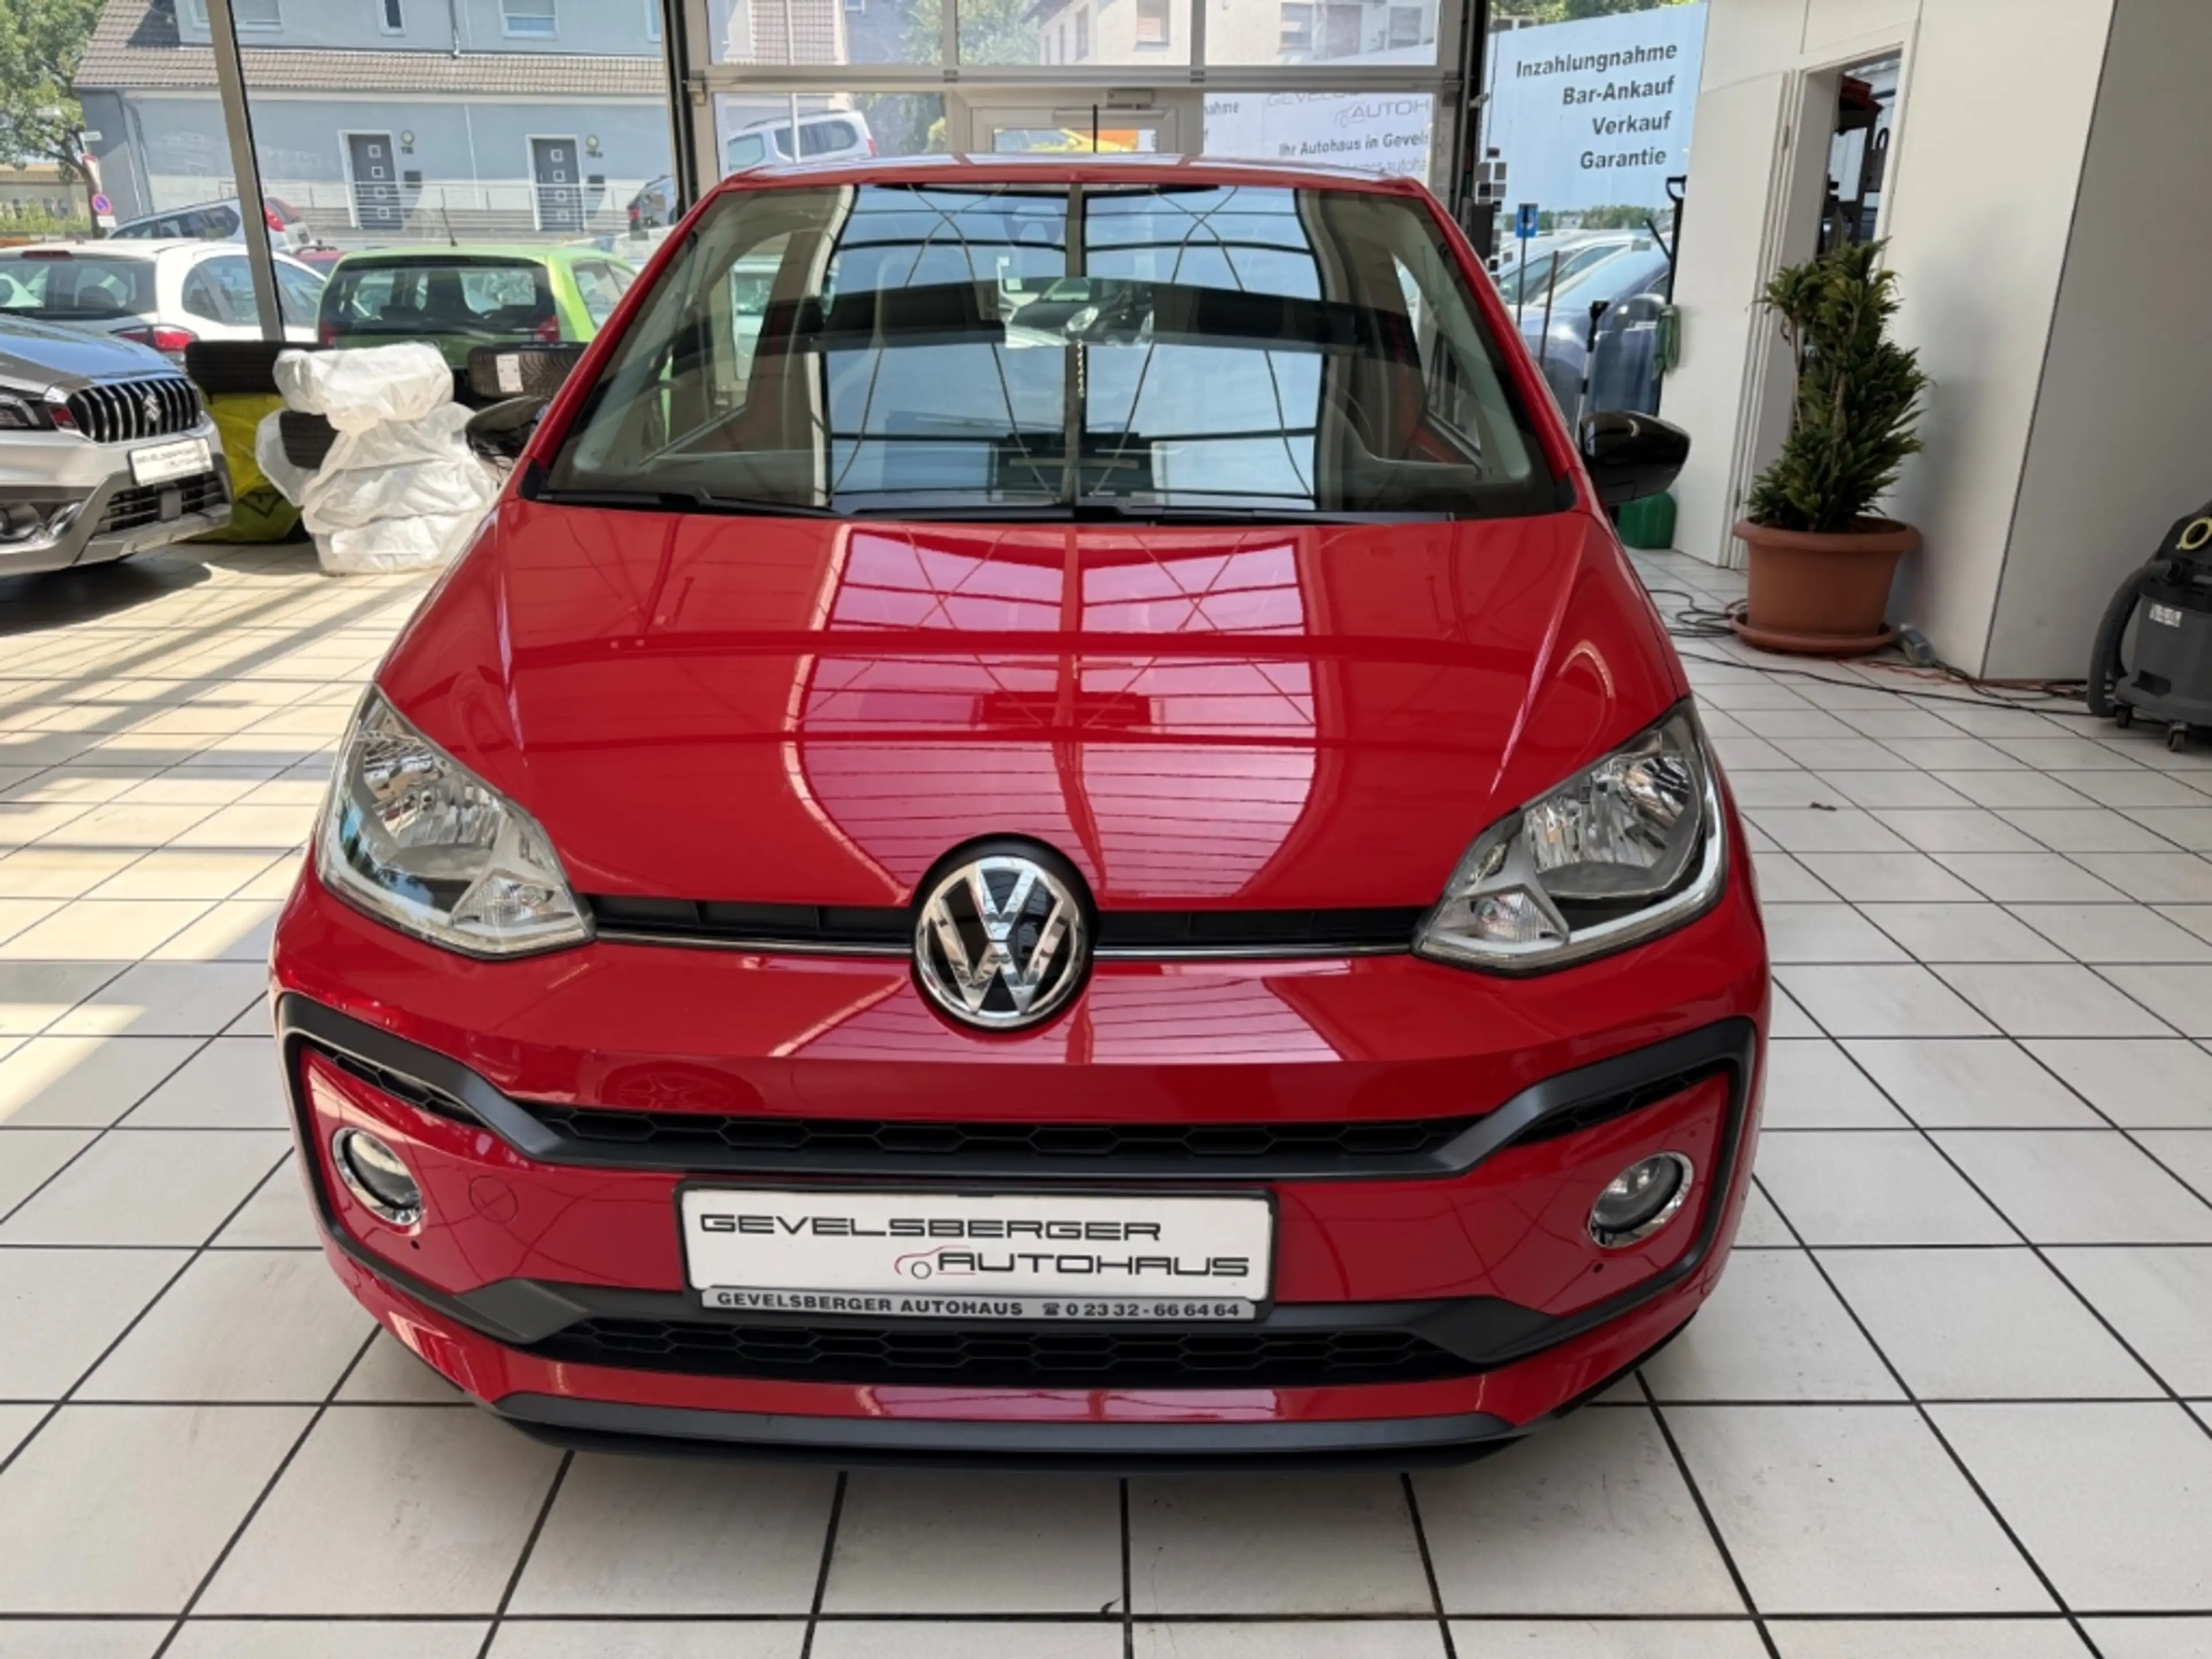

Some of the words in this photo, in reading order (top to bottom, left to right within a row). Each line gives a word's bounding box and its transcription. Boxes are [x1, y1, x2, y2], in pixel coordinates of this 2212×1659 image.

[1516, 44, 1677, 78] Inzahlungnahme
[1563, 75, 1675, 105] Bar-Ankauf
[1592, 110, 1672, 135] Verkauf
[1279, 143, 1296, 157] Ihr
[1300, 139, 1361, 156] Autohaus
[1365, 134, 1378, 150] in
[1580, 147, 1666, 169] Garantie
[700, 1214, 1161, 1241] GEVELSBERGER
[938, 1252, 1249, 1277] AUTOHAUS
[717, 1291, 892, 1312] GEVELSBERGER
[900, 1298, 1022, 1316] AUTOHAUS
